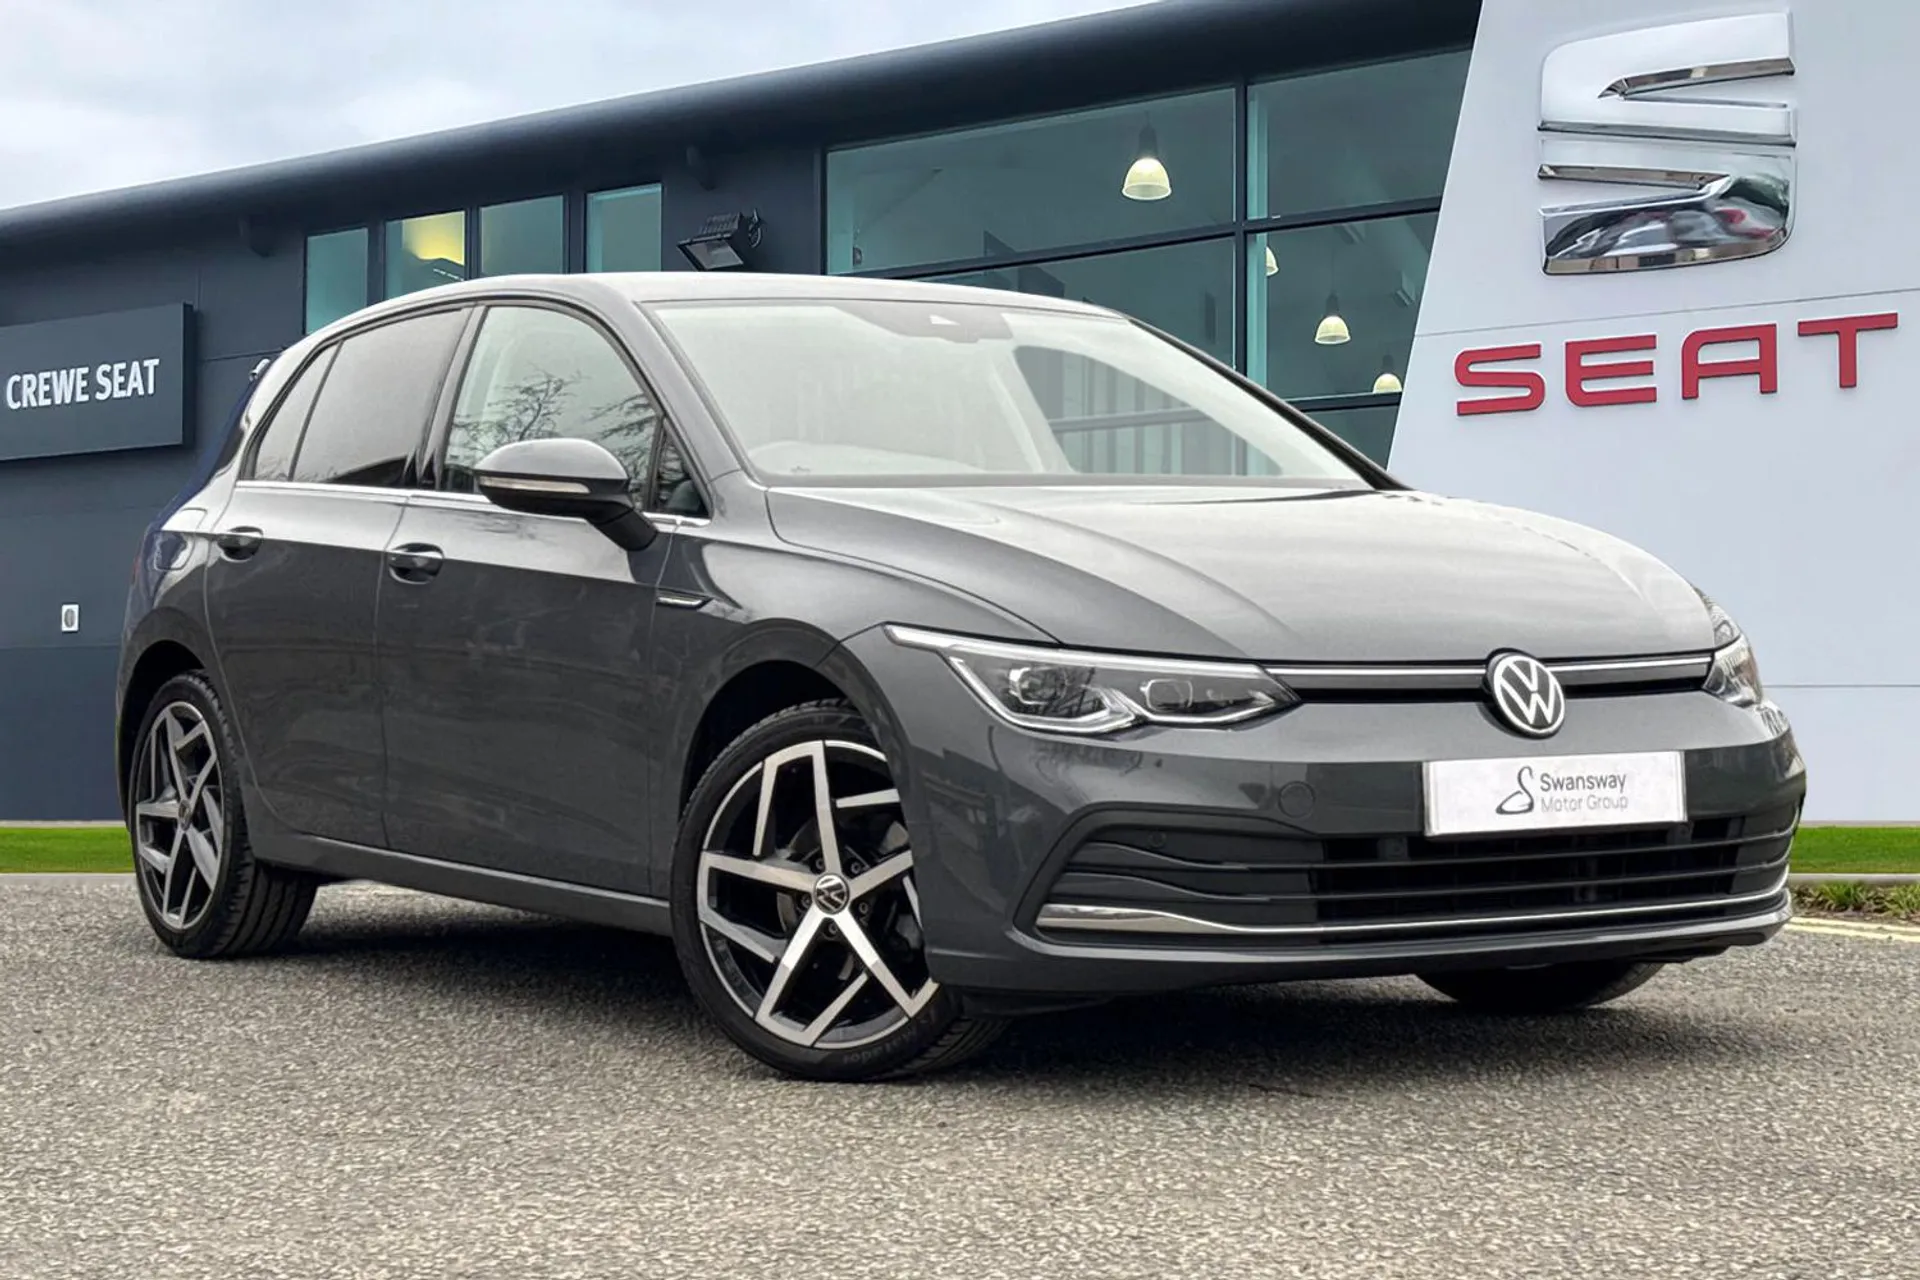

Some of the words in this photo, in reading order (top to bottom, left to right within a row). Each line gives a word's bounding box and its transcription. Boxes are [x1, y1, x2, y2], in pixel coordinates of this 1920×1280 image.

[1454, 312, 1899, 417] SEAT
[6, 366, 90, 410] CREWE
[95, 358, 160, 401] SEAT
[1540, 772, 1627, 794] Swansway
[1541, 797, 1583, 813] Motor
[1586, 794, 1629, 812] Group
